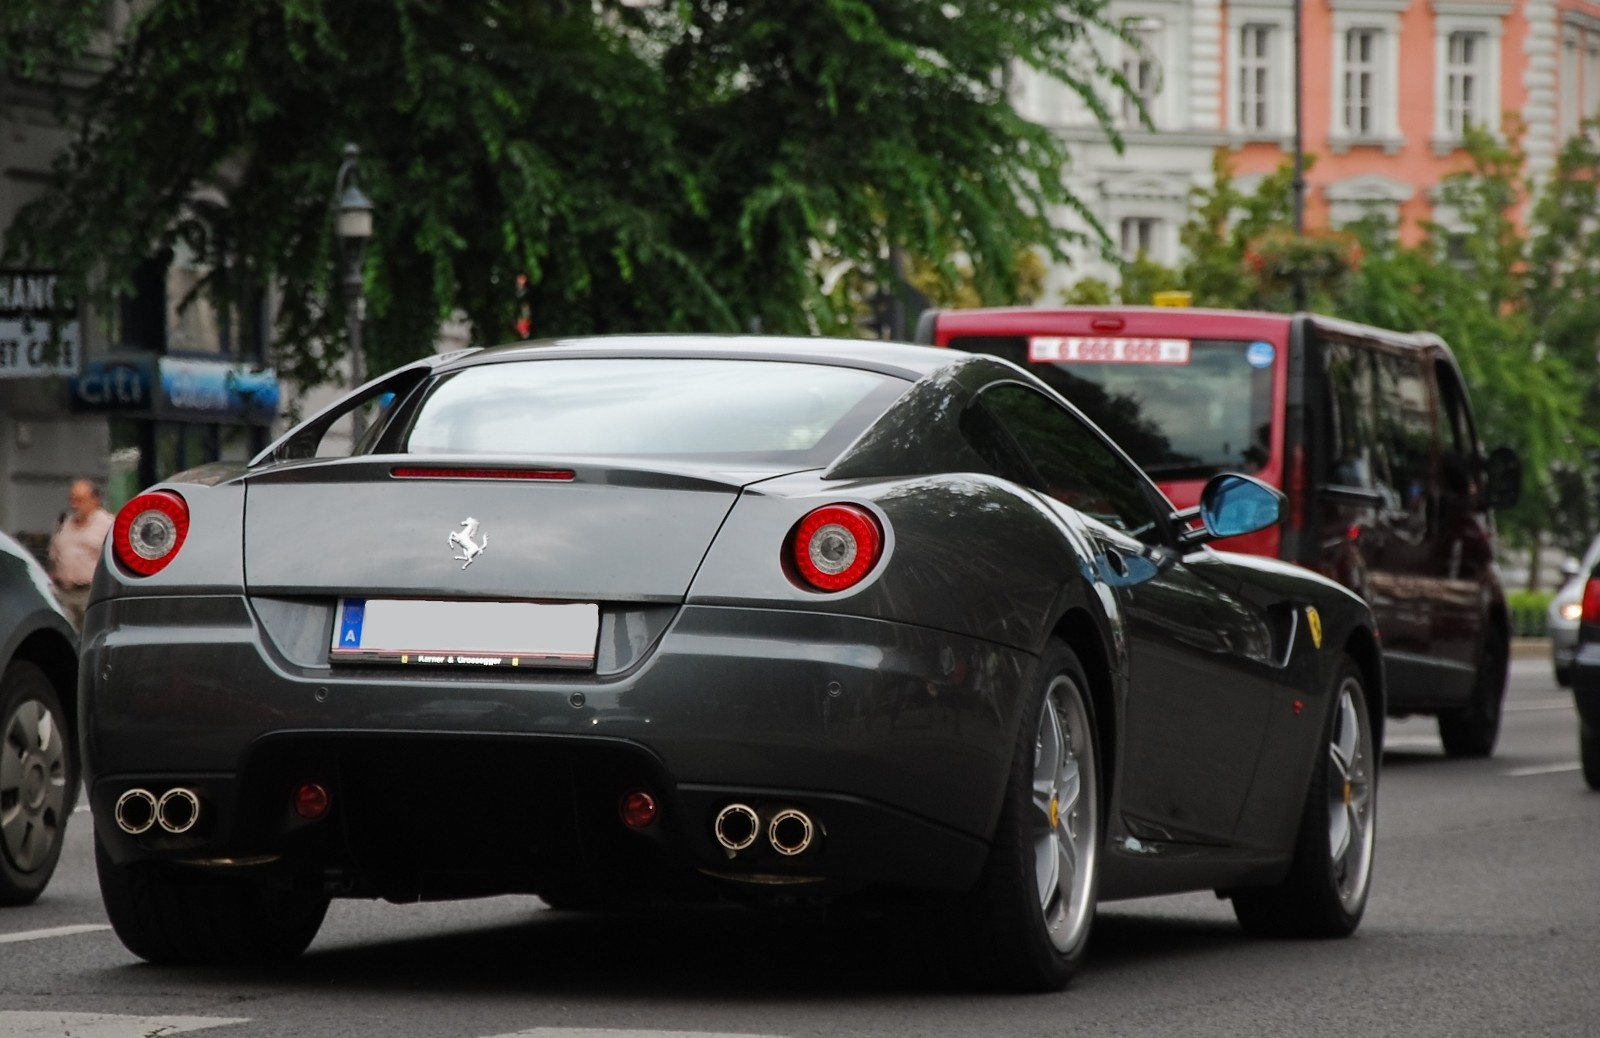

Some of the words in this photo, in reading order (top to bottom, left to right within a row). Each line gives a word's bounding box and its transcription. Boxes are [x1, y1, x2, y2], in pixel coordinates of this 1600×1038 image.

[79, 368, 142, 403] citi
[345, 629, 356, 642] A
[447, 656, 454, 664] &
